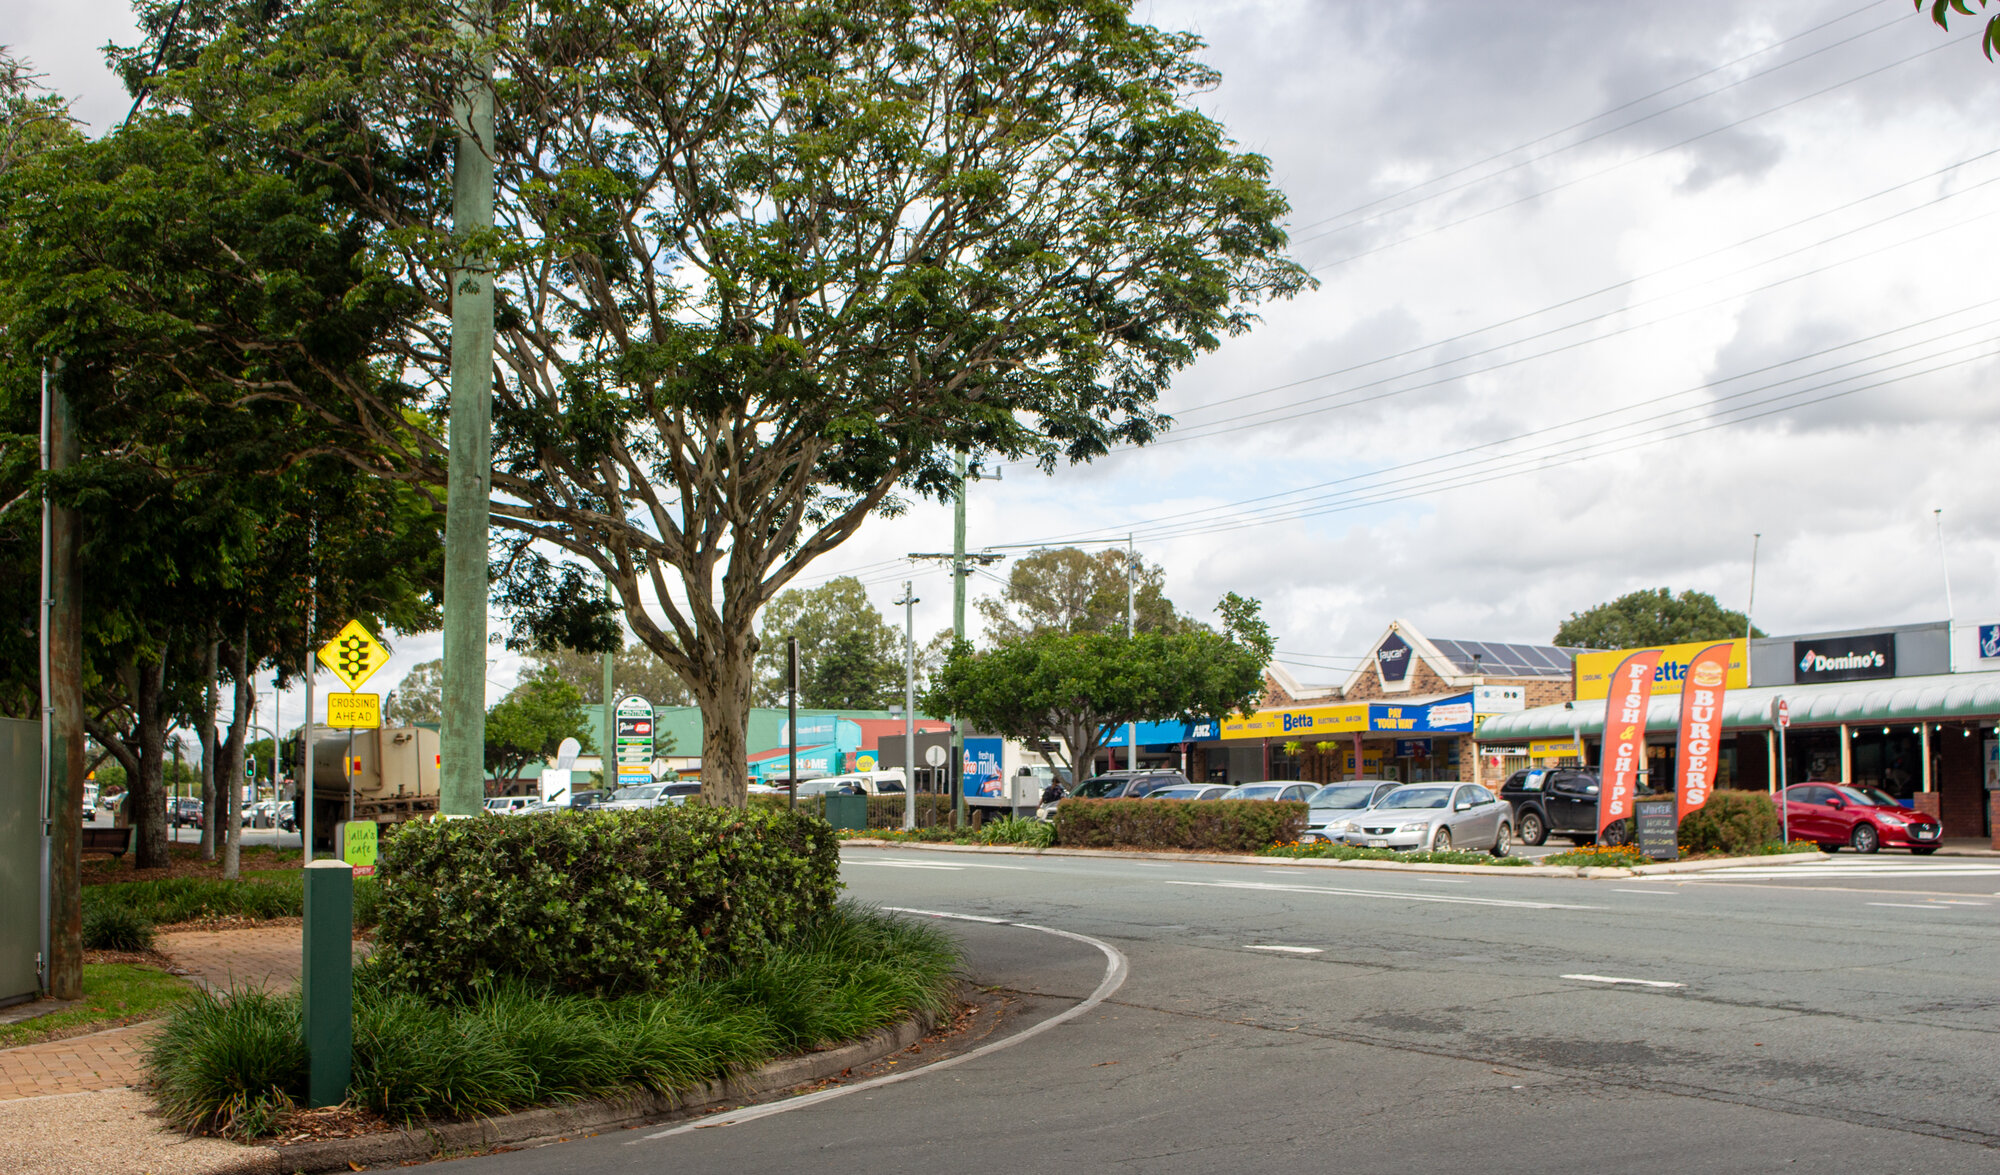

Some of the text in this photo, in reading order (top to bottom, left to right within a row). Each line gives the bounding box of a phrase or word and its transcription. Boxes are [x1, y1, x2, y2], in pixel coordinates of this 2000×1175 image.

[1379, 648, 1404, 662] jaycar
[1814, 650, 1885, 672] Domino's
[1582, 673, 1602, 681] COOLING
[1654, 661, 1688, 682] etta
[331, 698, 376, 708] CROSSING
[335, 711, 372, 721] AHEAD
[622, 709, 647, 717] CENTRAL
[1388, 708, 1402, 718] PAY
[1283, 713, 1313, 732] Betta
[1318, 716, 1340, 725] ELECTRICAL
[1193, 724, 1210, 738] ANZ
[1609, 664, 1648, 815] FISH & CHIPS
[1686, 690, 1715, 805] BURGERS
[978, 753, 1000, 775] milk
[1348, 758, 1377, 769] Btta
[1641, 805, 1671, 814] WINTER
[351, 841, 371, 857] cafe
